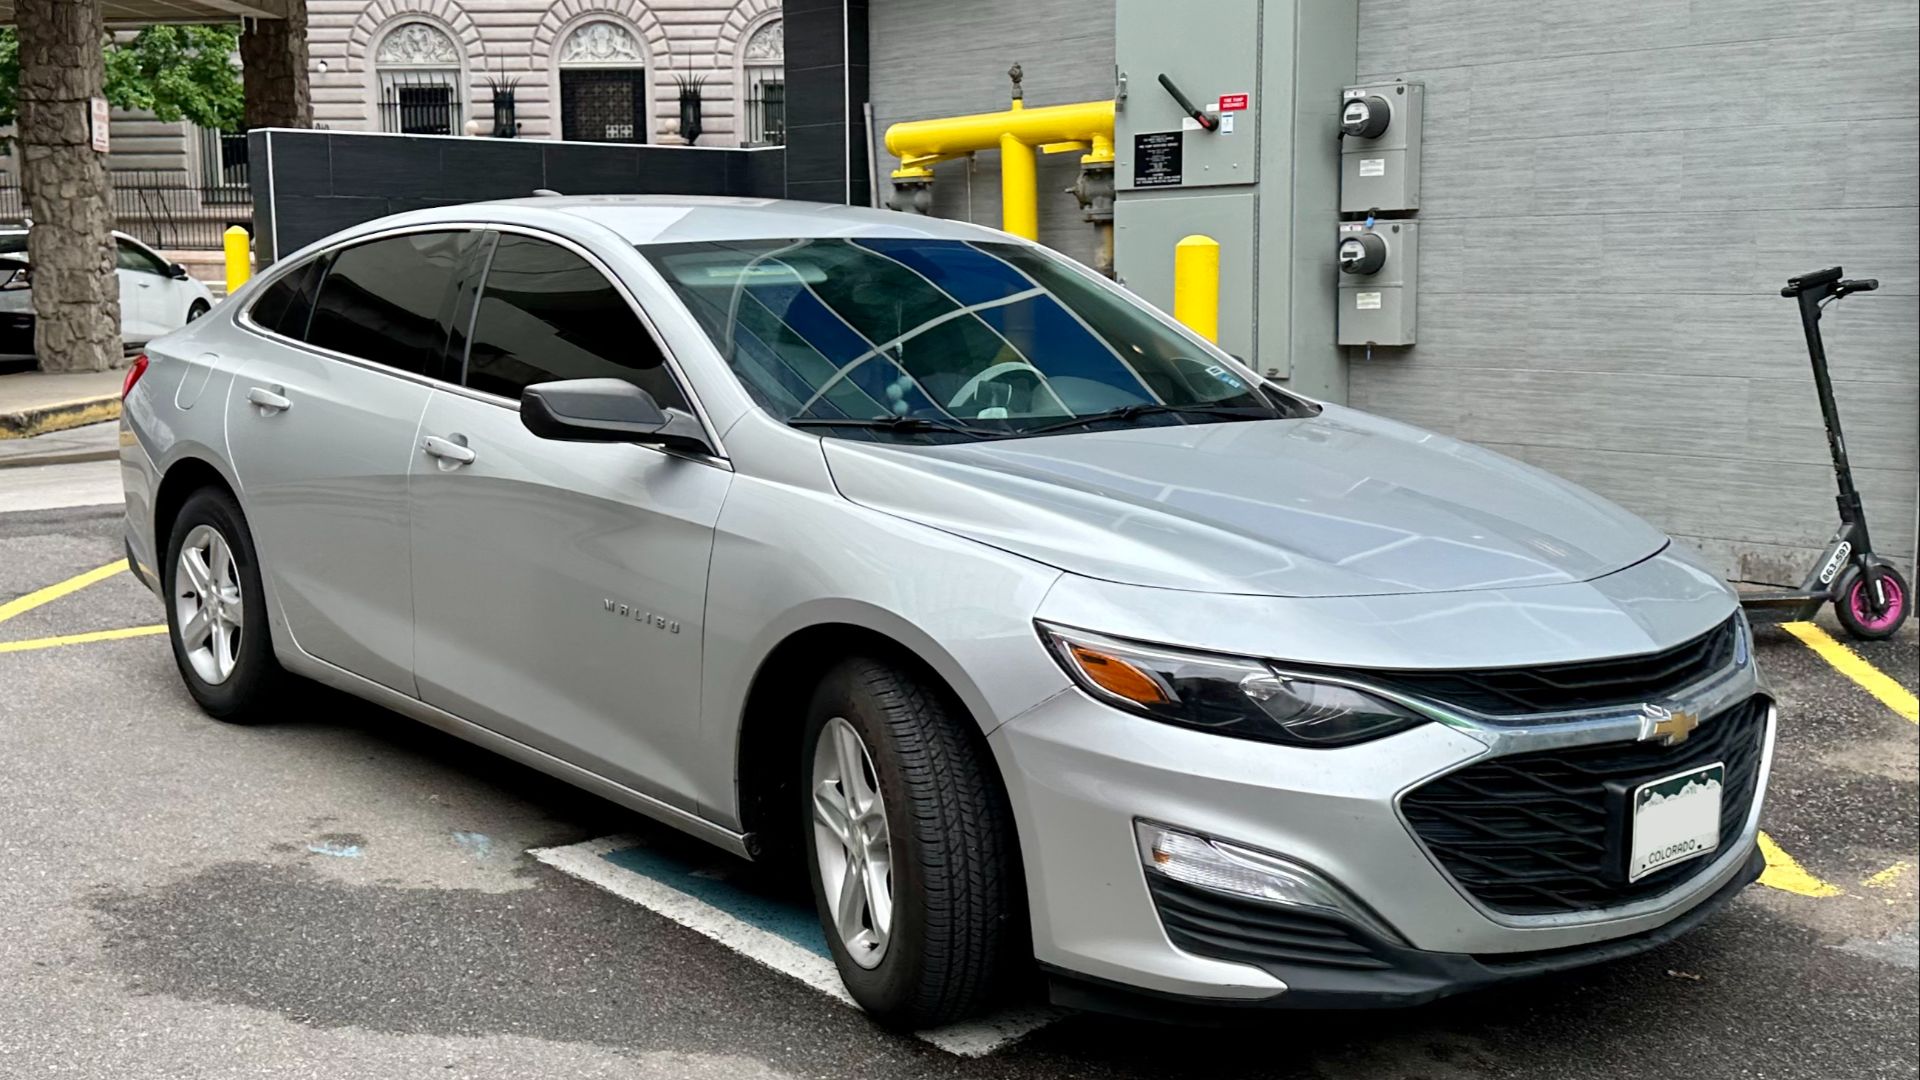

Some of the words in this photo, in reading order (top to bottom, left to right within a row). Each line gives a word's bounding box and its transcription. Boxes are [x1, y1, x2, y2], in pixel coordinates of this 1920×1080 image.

[1822, 543, 1849, 582] 863-597
[603, 598, 681, 635] MALIBU
[1648, 839, 1696, 865] COLORADO
